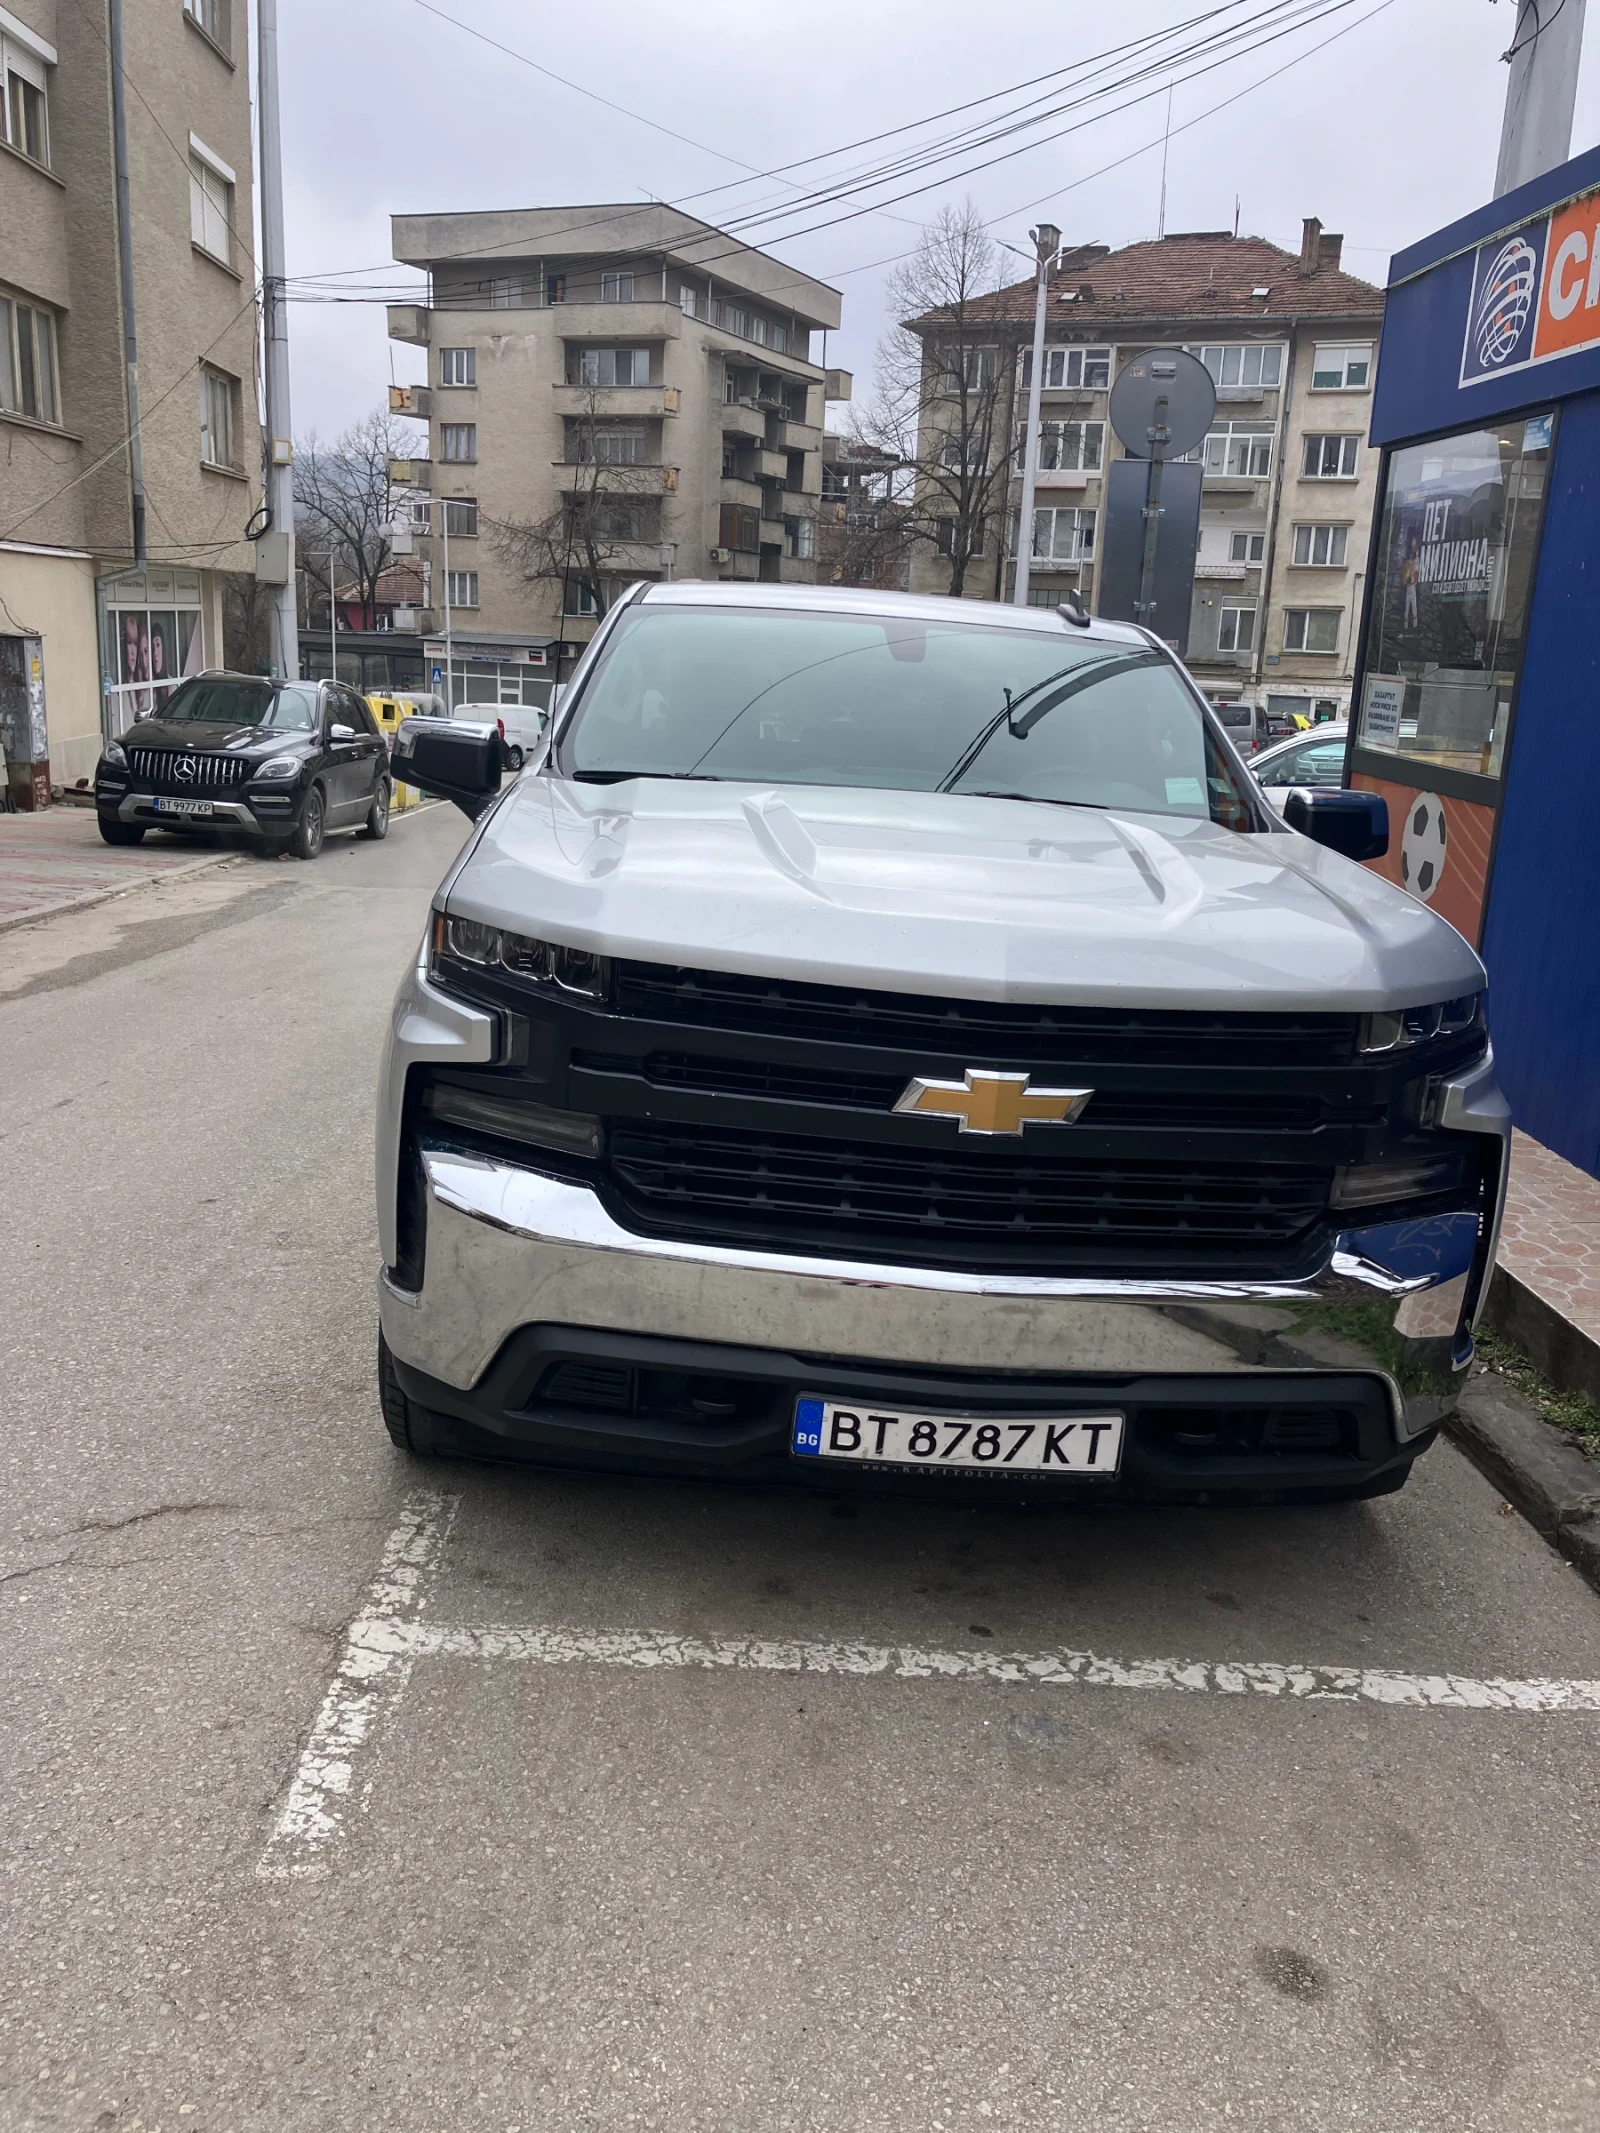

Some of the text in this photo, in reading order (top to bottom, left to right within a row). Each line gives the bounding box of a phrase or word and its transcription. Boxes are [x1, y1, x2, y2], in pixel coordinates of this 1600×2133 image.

[1422, 498, 1452, 542] ПЕТ
[1418, 538, 1488, 583] МИЛИОНА
[1484, 556, 1495, 591] ЕВРО
[160, 800, 172, 810] BT
[173, 801, 197, 812] 9977
[198, 803, 211, 813] KP
[797, 1432, 818, 1447] BG
[829, 1410, 1112, 1465] BT 8787 KT
